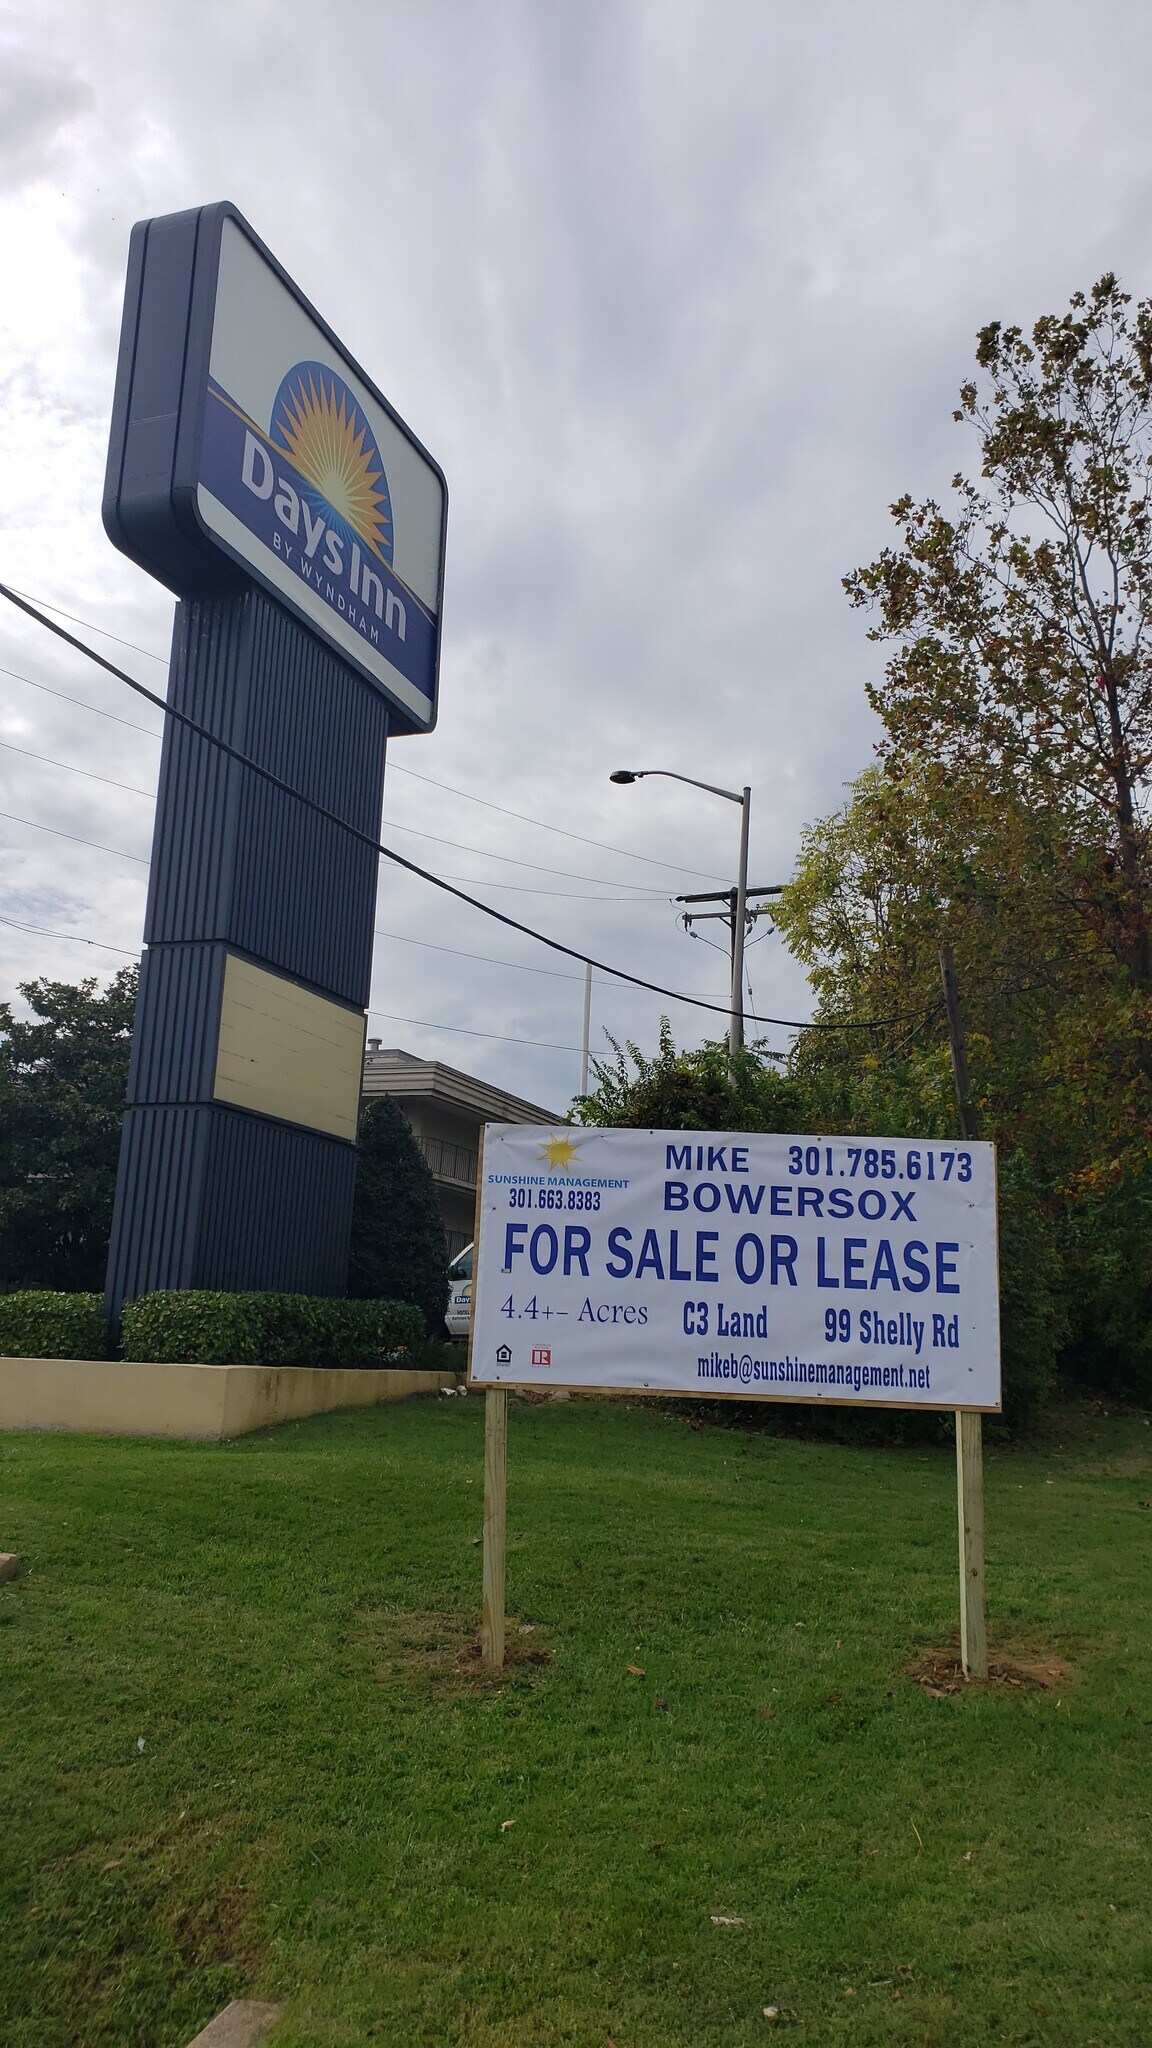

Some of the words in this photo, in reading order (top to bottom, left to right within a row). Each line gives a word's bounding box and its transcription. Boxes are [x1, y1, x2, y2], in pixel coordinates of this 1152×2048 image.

[241, 430, 344, 575] Days
[349, 542, 407, 642] Inn
[273, 531, 293, 560] BY
[300, 557, 380, 642] WYNDHAM
[665, 1144, 750, 1173] MIKE
[788, 1145, 973, 1183] 301.785.6173
[488, 1174, 545, 1186] SUNSHINE
[547, 1177, 630, 1189] MANAGEMENT
[508, 1187, 601, 1211] 301.663.8383
[664, 1181, 918, 1222] BOWERSOX
[504, 1222, 592, 1277] FOR
[605, 1226, 720, 1283] SALE
[734, 1232, 799, 1287] OR
[816, 1236, 961, 1295] LEASE
[577, 1296, 649, 1325] Acres
[683, 1301, 709, 1336] C3
[716, 1303, 768, 1339] Land
[824, 1308, 851, 1343] 99
[859, 1309, 925, 1355] Shelly
[932, 1313, 960, 1349] Rd
[697, 1351, 931, 1392] mikeb@sunshinemanagement.net
